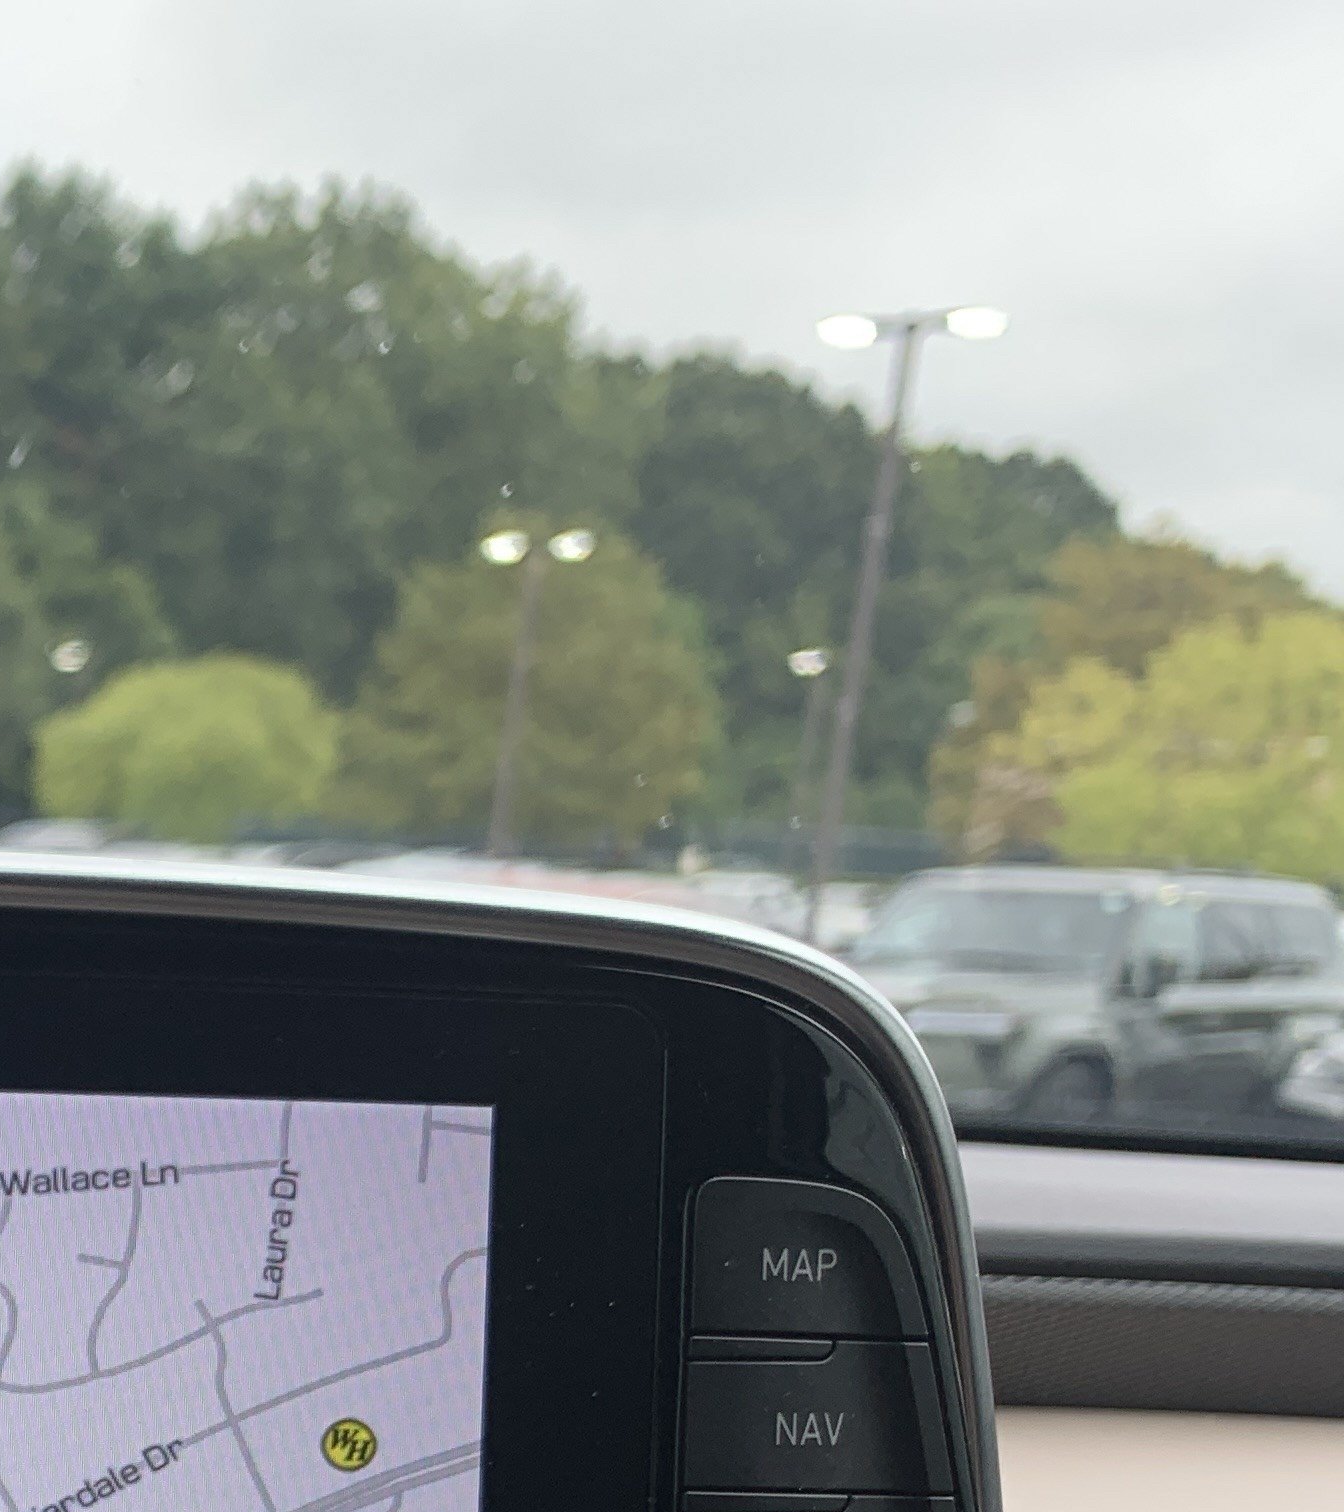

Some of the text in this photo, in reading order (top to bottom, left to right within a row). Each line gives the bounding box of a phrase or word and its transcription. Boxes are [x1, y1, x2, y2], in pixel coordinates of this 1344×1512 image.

[140, 1161, 180, 1186] Ln
[254, 1159, 302, 1300] Laura Dr
[761, 1248, 839, 1283] MAP
[775, 1412, 845, 1446] NAV
[142, 1437, 185, 1475] Dr
